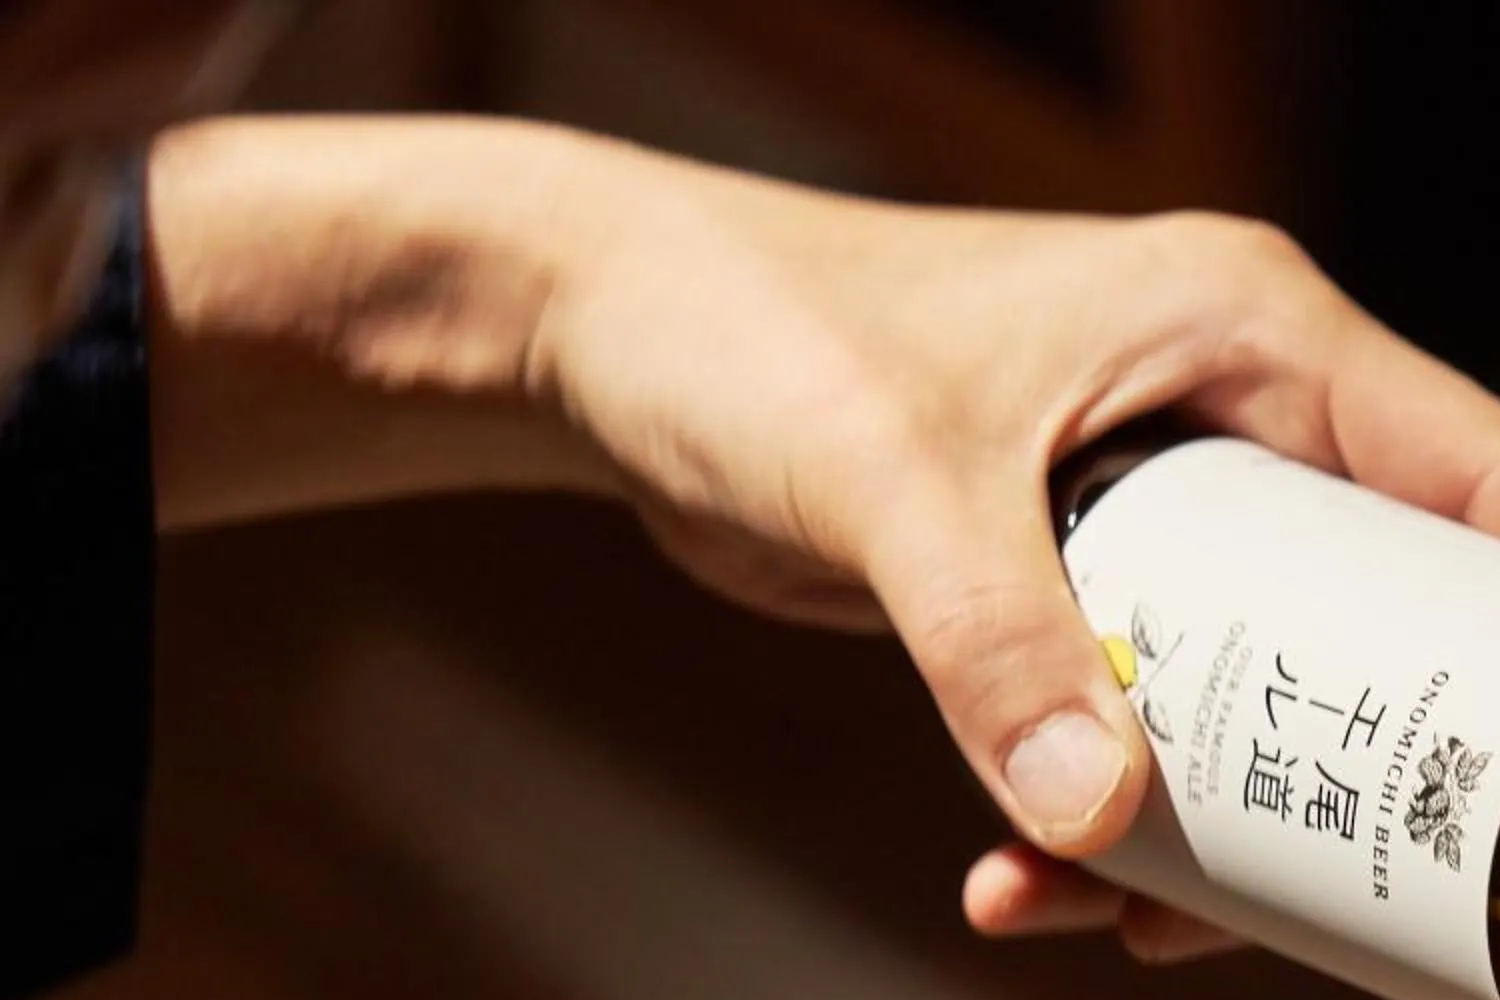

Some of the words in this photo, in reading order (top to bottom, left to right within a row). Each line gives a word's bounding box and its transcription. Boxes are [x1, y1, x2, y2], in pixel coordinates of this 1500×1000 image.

[1190, 620, 1246, 749] ONOMICHI
[1264, 651, 1387, 751] エール
[1186, 752, 1203, 807] ALE
[1242, 736, 1361, 843] 尾道
[1376, 669, 1450, 816] ONOMICHI
[1372, 826, 1391, 901] BEER
